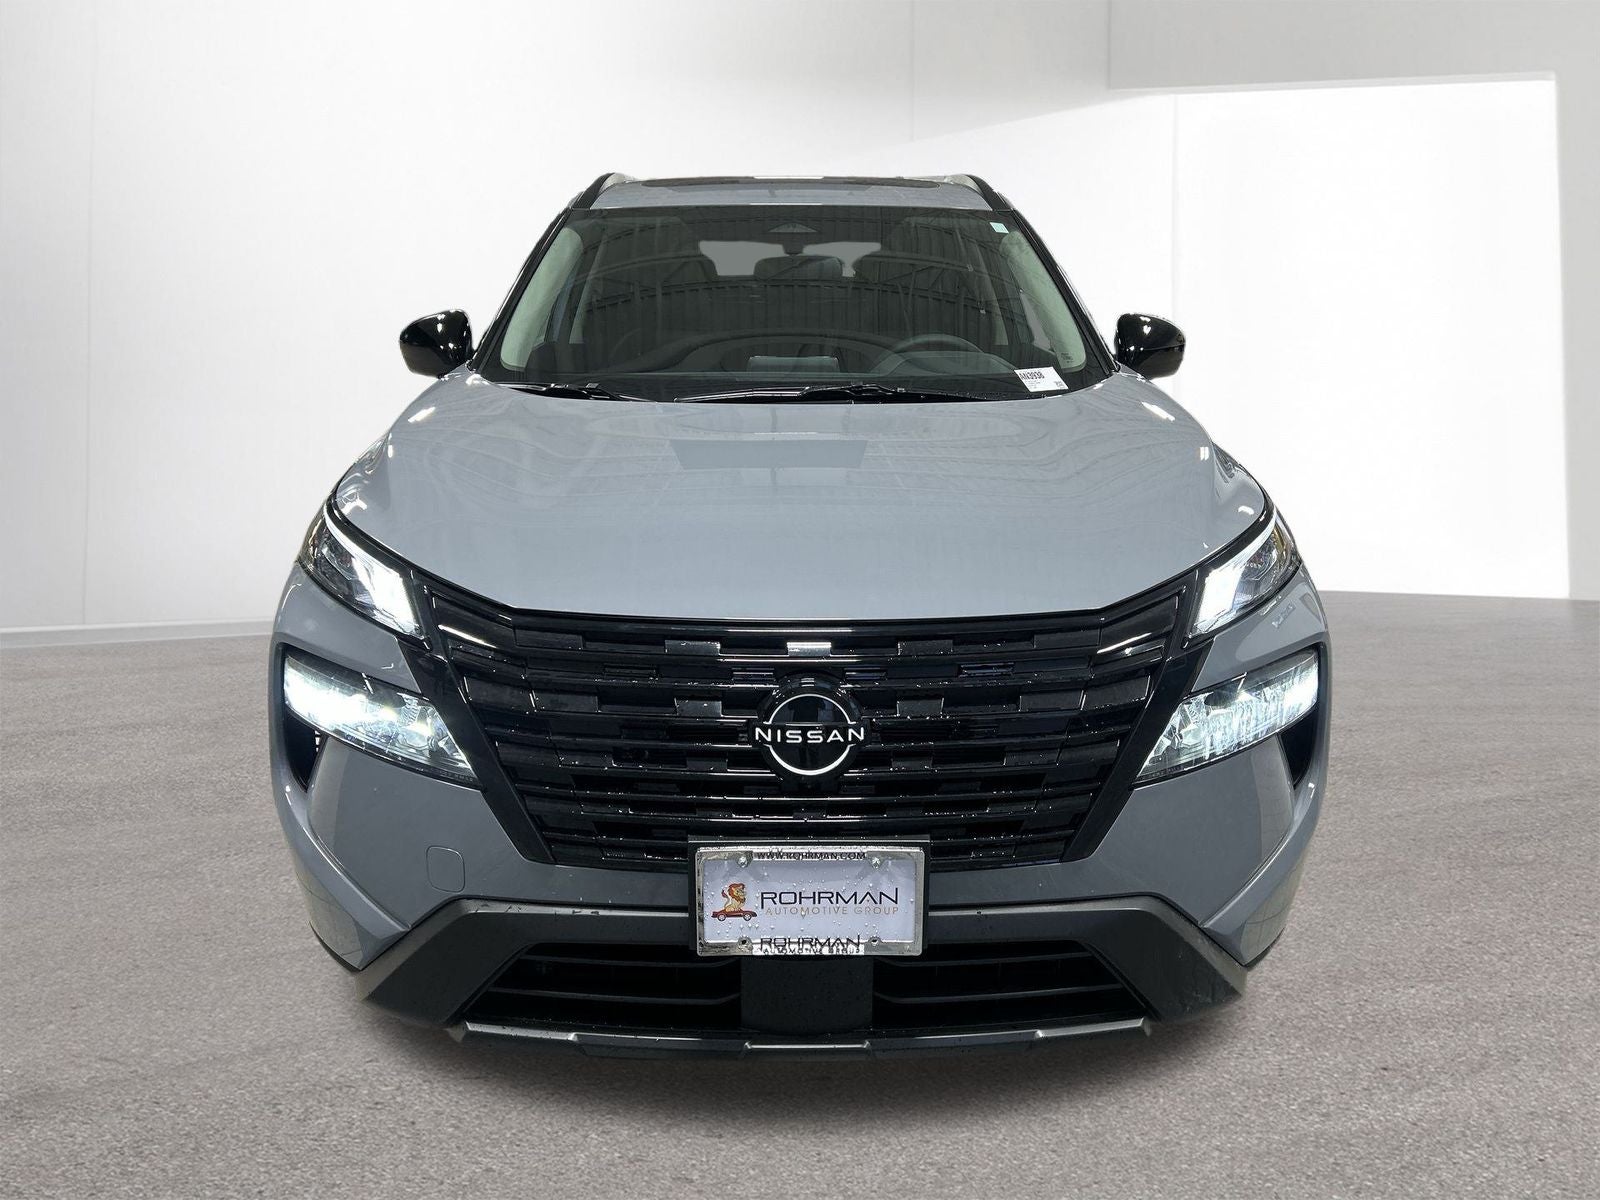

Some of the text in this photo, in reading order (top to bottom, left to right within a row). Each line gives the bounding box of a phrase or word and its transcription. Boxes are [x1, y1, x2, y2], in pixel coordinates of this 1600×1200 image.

[755, 727, 865, 743] NISSAN
[757, 852, 866, 860] WWW.ROHRMAN.COM
[761, 888, 899, 909] ROHRMAN
[765, 906, 899, 915] AUTOMOTIVE GROUP
[760, 934, 860, 951] ROHRMAN
